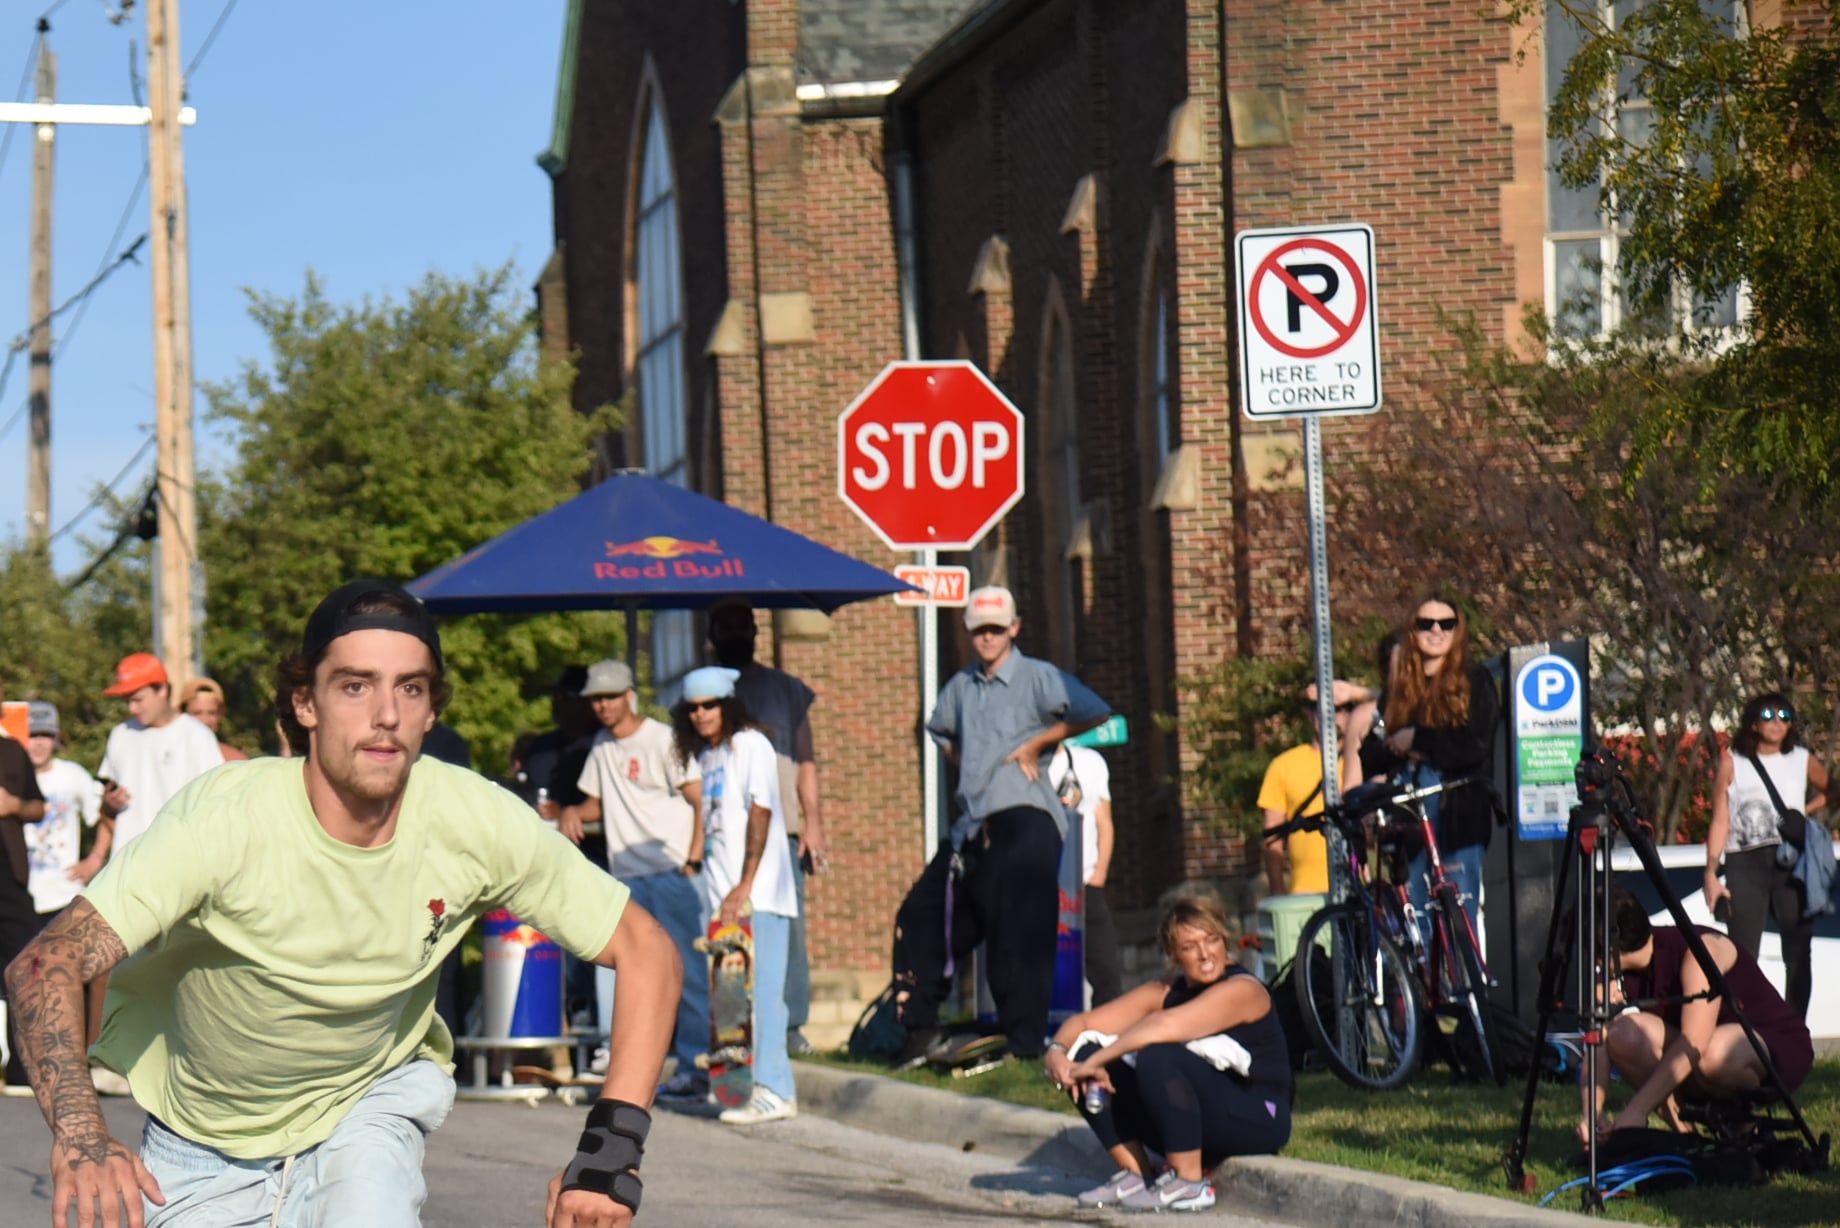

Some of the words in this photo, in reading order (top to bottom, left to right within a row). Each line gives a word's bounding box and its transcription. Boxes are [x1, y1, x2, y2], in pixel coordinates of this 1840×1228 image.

[1260, 364, 1317, 384] HERE
[1336, 362, 1361, 379] TO
[1268, 384, 1355, 406] CORNER
[852, 420, 1010, 491] STOP
[593, 560, 667, 580] Red
[672, 557, 745, 578] Bull
[1537, 669, 1566, 707] P
[1532, 748, 1569, 760] Parking
